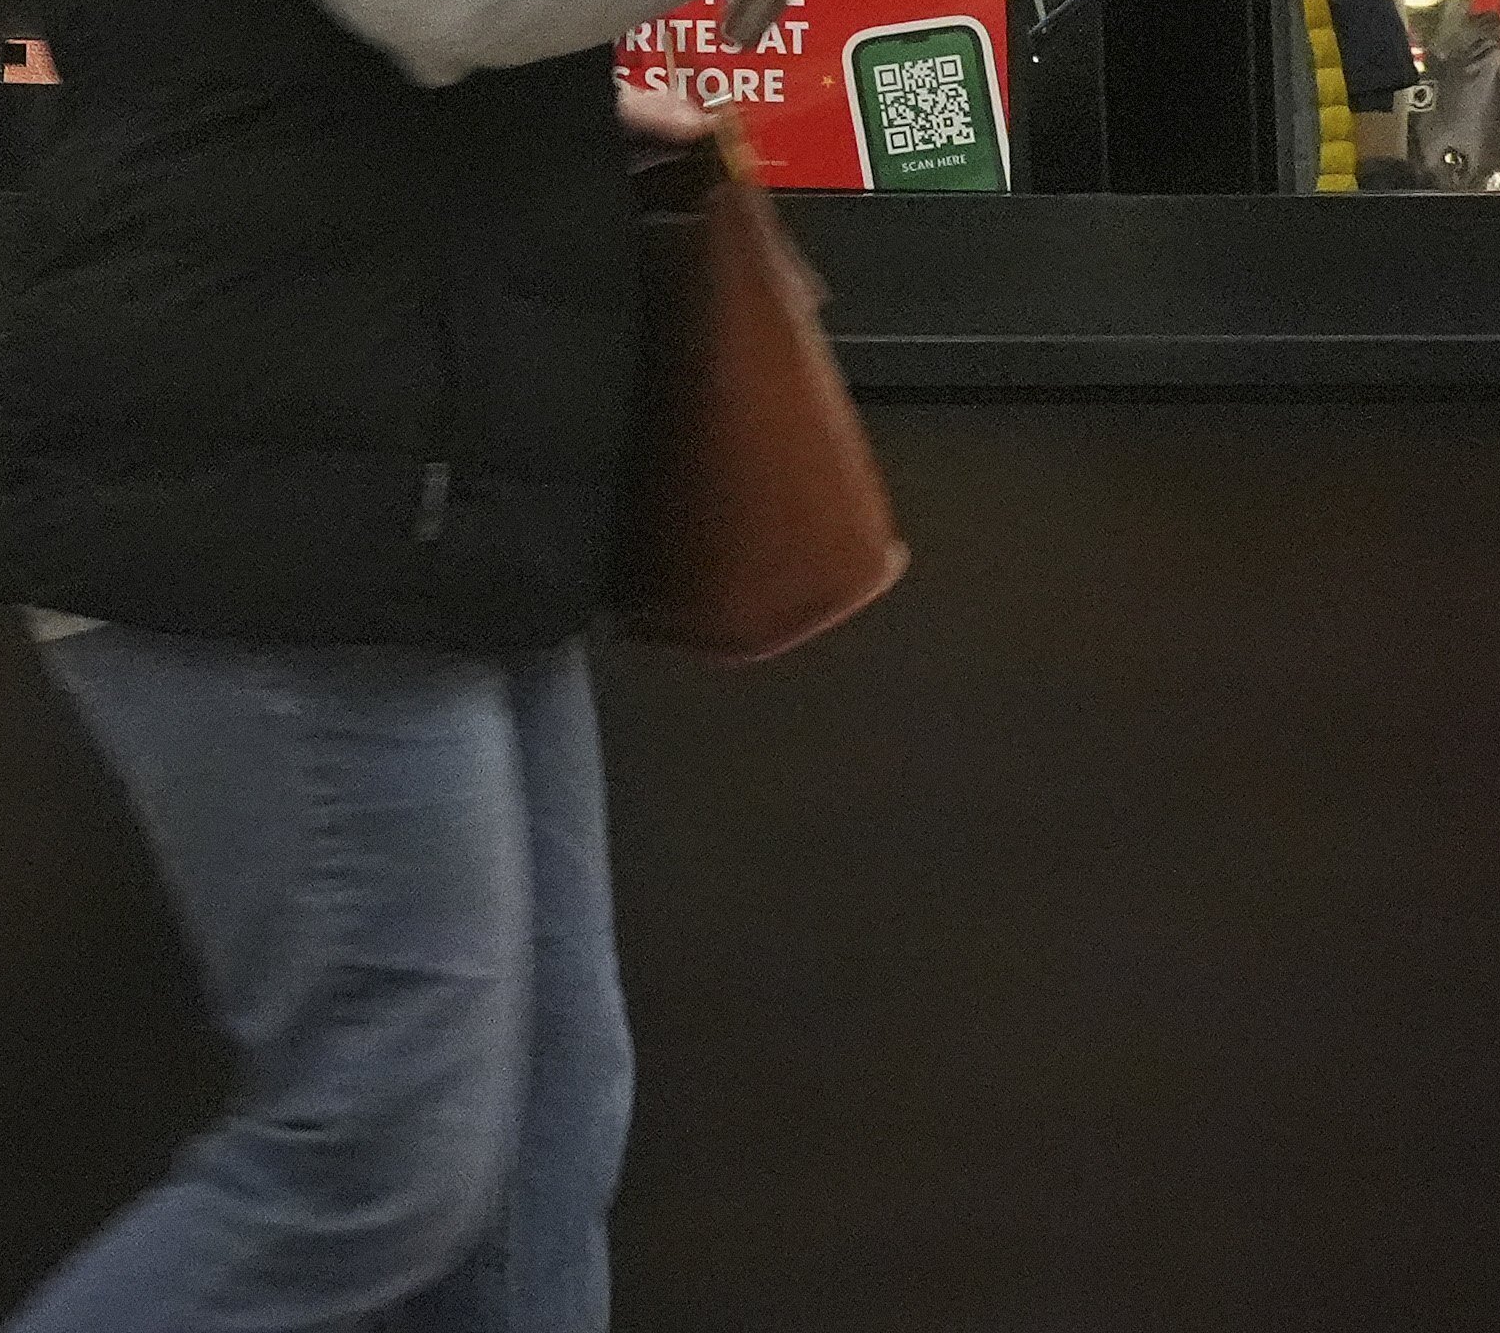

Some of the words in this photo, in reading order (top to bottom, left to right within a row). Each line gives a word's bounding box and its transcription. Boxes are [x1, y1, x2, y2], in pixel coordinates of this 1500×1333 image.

[756, 21, 810, 55] AT
[644, 66, 785, 103] STORE
[902, 158, 935, 174] SCAN
[938, 154, 967, 169] HERE
